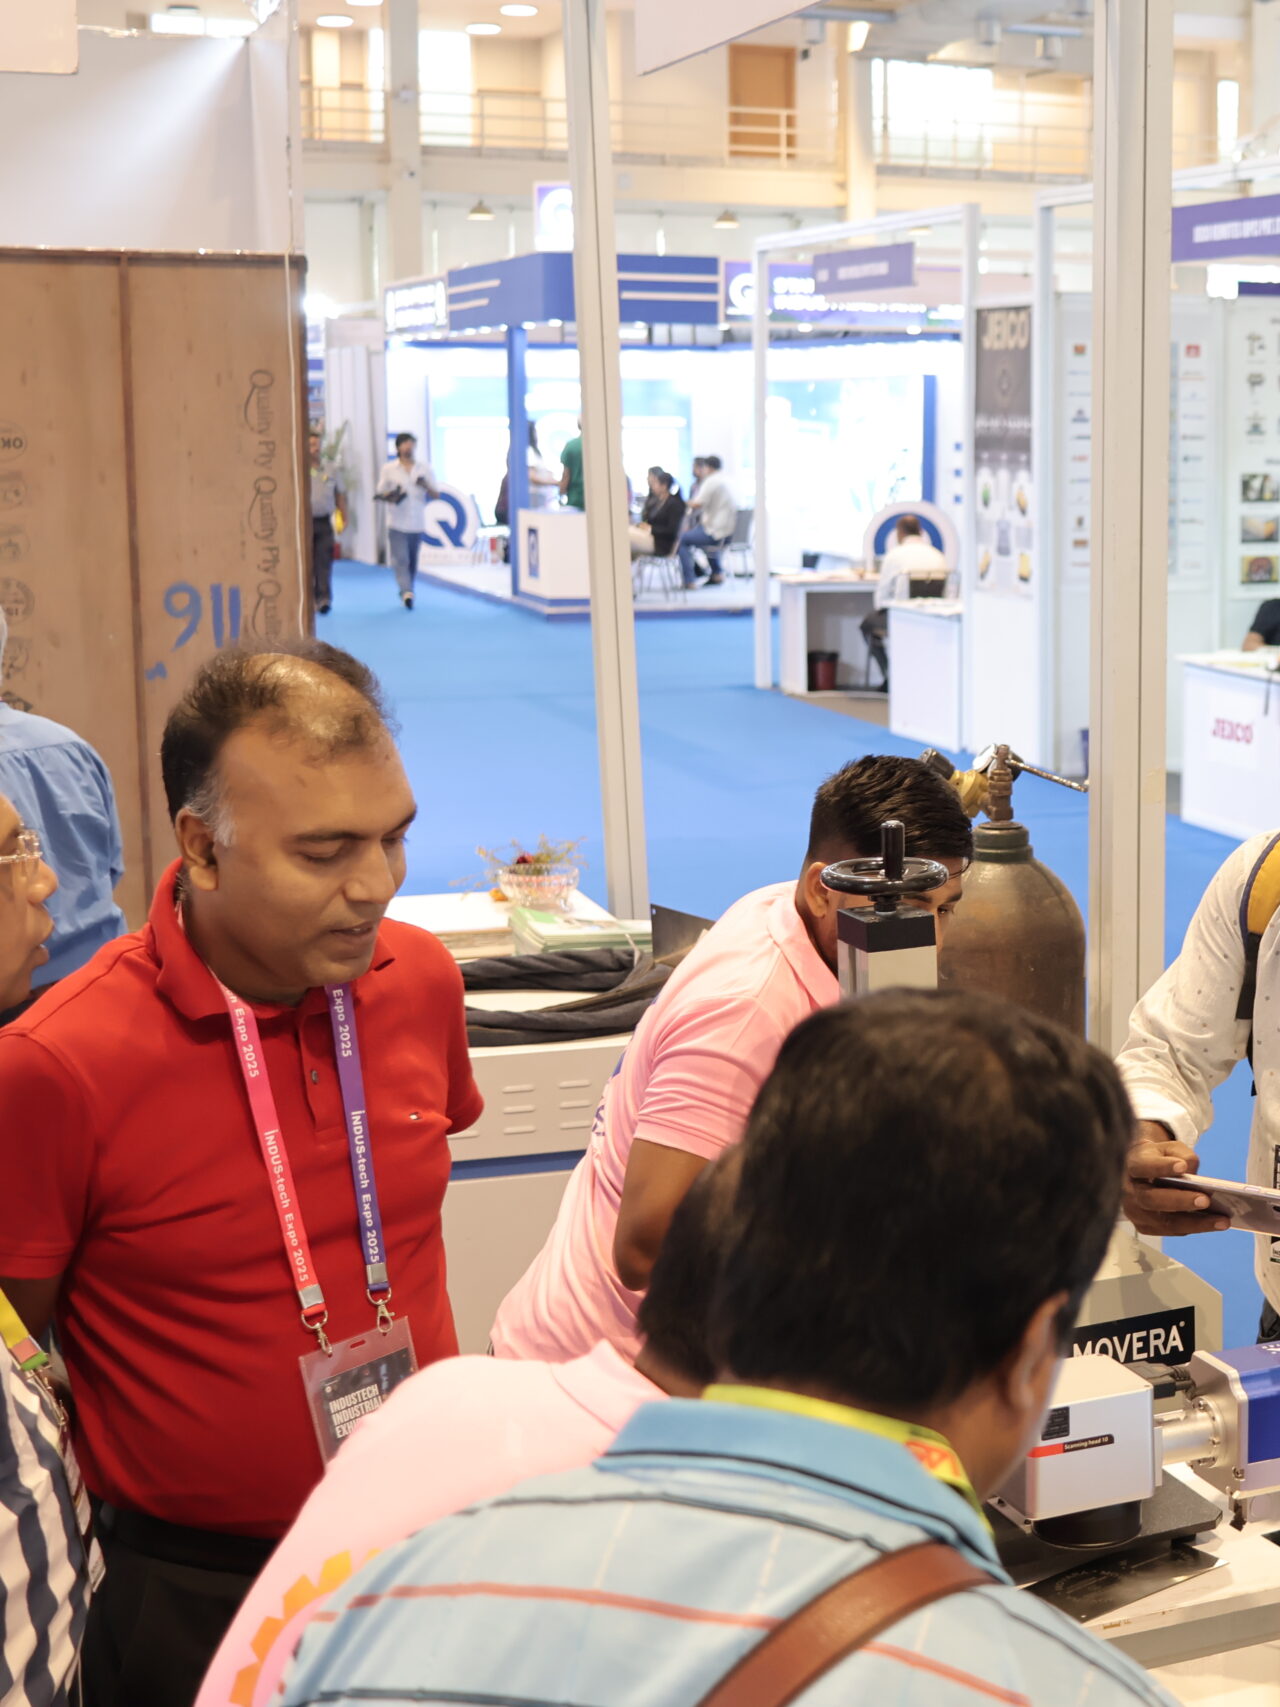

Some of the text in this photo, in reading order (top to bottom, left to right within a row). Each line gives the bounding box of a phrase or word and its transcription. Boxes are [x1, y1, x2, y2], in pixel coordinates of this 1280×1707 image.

[332, 988, 353, 1058] Expo 2025
[234, 1007, 260, 1078] Expo 2025
[361, 1193, 373, 1227] Expo
[284, 1212, 299, 1246] Expo
[293, 1248, 309, 1282] 2025
[366, 1229, 380, 1263] 2025
[329, 1383, 380, 1414] INDUSTECH
[1064, 1440, 1088, 1451] Scanning
[1088, 1438, 1101, 1446] head
